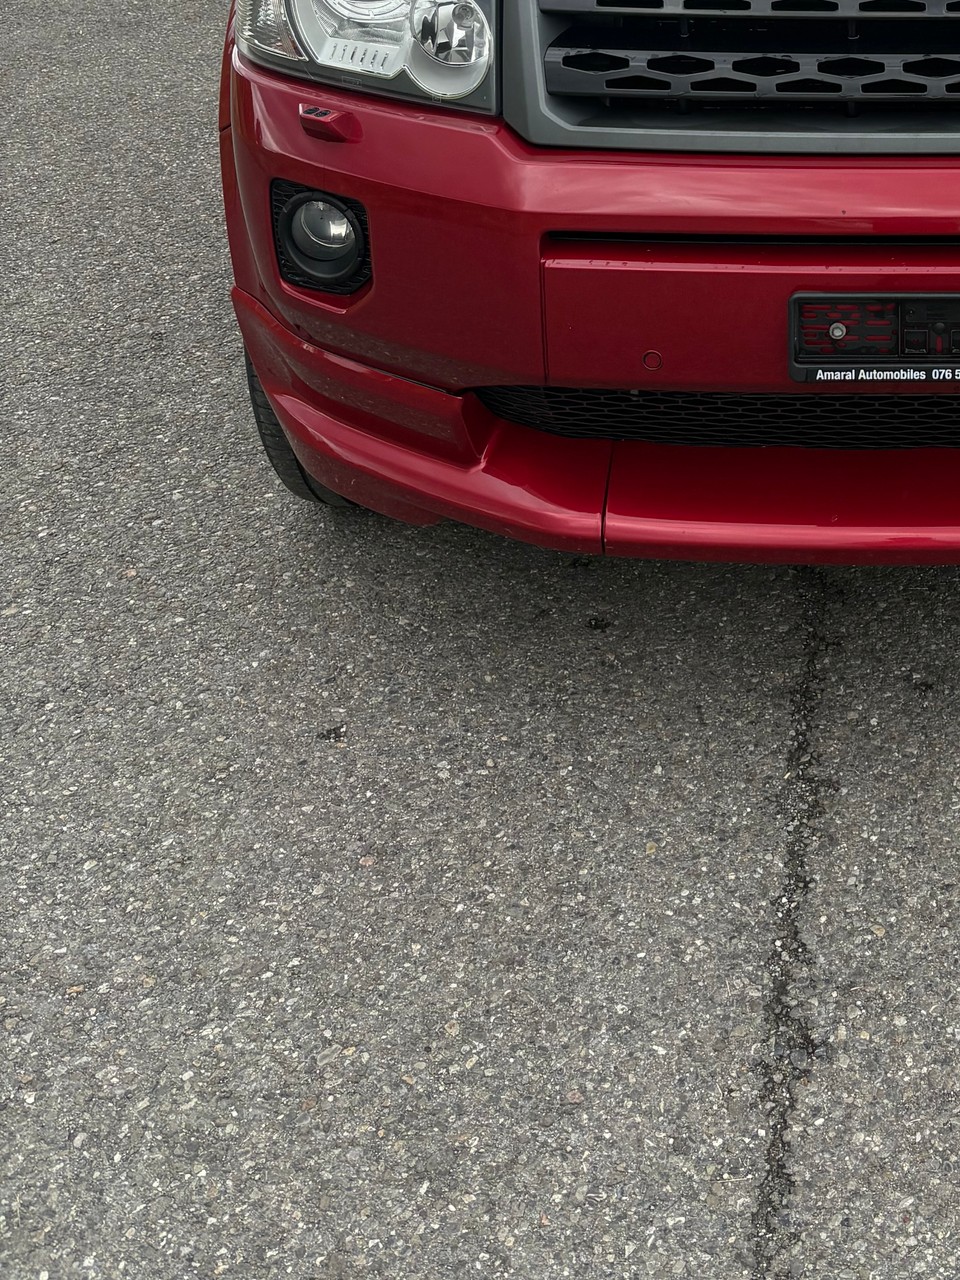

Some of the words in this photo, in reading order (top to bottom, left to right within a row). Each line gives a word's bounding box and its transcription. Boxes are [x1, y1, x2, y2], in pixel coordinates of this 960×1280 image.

[816, 369, 855, 380] Amaral
[858, 369, 926, 380] Automobiles
[931, 369, 952, 380] 076
